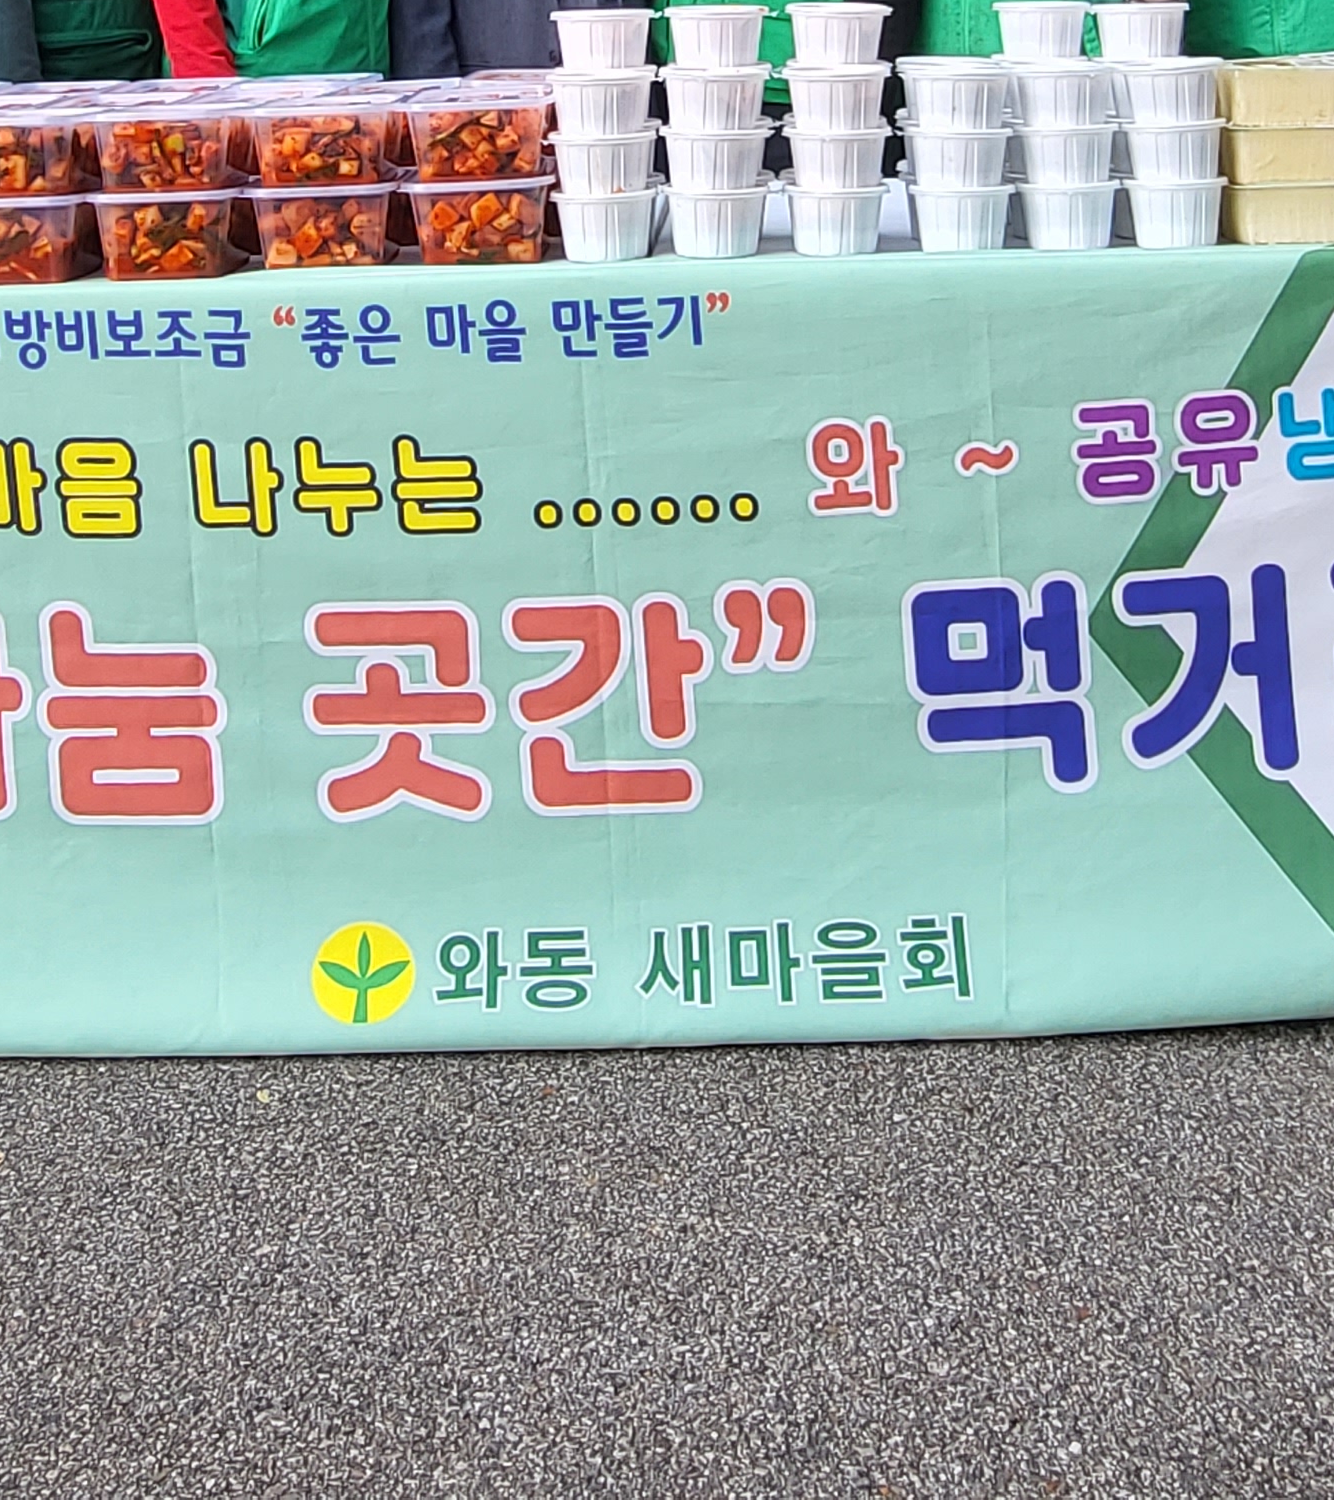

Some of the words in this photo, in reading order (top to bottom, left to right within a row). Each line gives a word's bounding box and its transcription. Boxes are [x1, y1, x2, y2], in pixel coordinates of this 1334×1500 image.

[273, 304, 402, 368] “좋은
[426, 300, 527, 363] 마을
[552, 293, 730, 358] 만들기”
[189, 435, 482, 536] 나누는
[809, 417, 903, 516] 와
[307, 580, 811, 821] 곳간”
[434, 926, 595, 1011] 와동
[637, 911, 973, 1006] 새마을회
